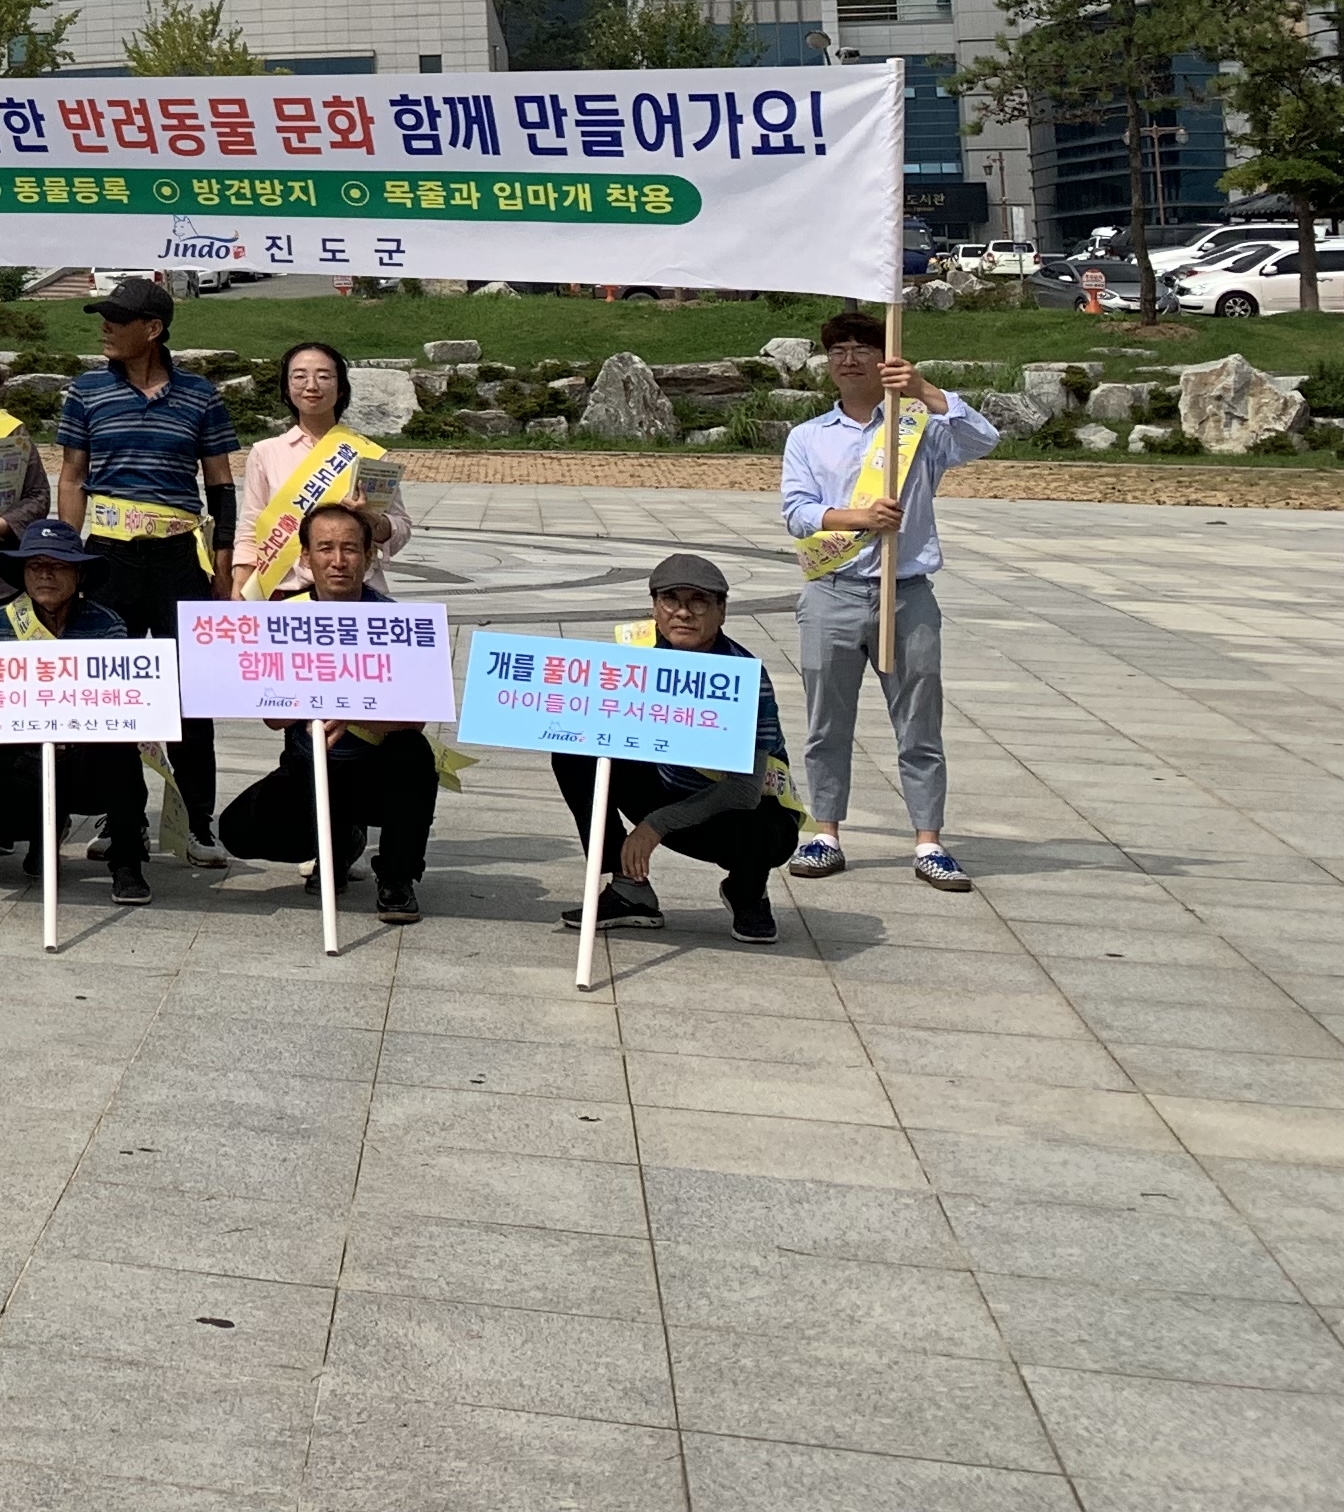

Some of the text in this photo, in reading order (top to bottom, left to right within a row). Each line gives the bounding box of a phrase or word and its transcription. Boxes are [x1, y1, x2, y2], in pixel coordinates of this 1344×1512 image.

[57, 97, 257, 157] 반려동물
[273, 95, 375, 156] 문화
[389, 93, 501, 156] 함께
[515, 89, 827, 160] 만들어가요!
[13, 177, 130, 204] 동물등록
[192, 177, 317, 207] 방견방지
[383, 180, 674, 214] 목줄과 입마개 착용
[157, 239, 231, 260] Jindo
[192, 615, 436, 648] 성숙한 반려동물 문화를
[36, 657, 79, 681] 놓지
[87, 655, 161, 681] 마세요!
[238, 651, 393, 683] 함께 만듭시다!
[487, 651, 740, 703] 개를 풀어 놓지 마세요!
[36, 689, 151, 707] 무서워해요.
[497, 689, 728, 731] 아이들이 무서워해요.
